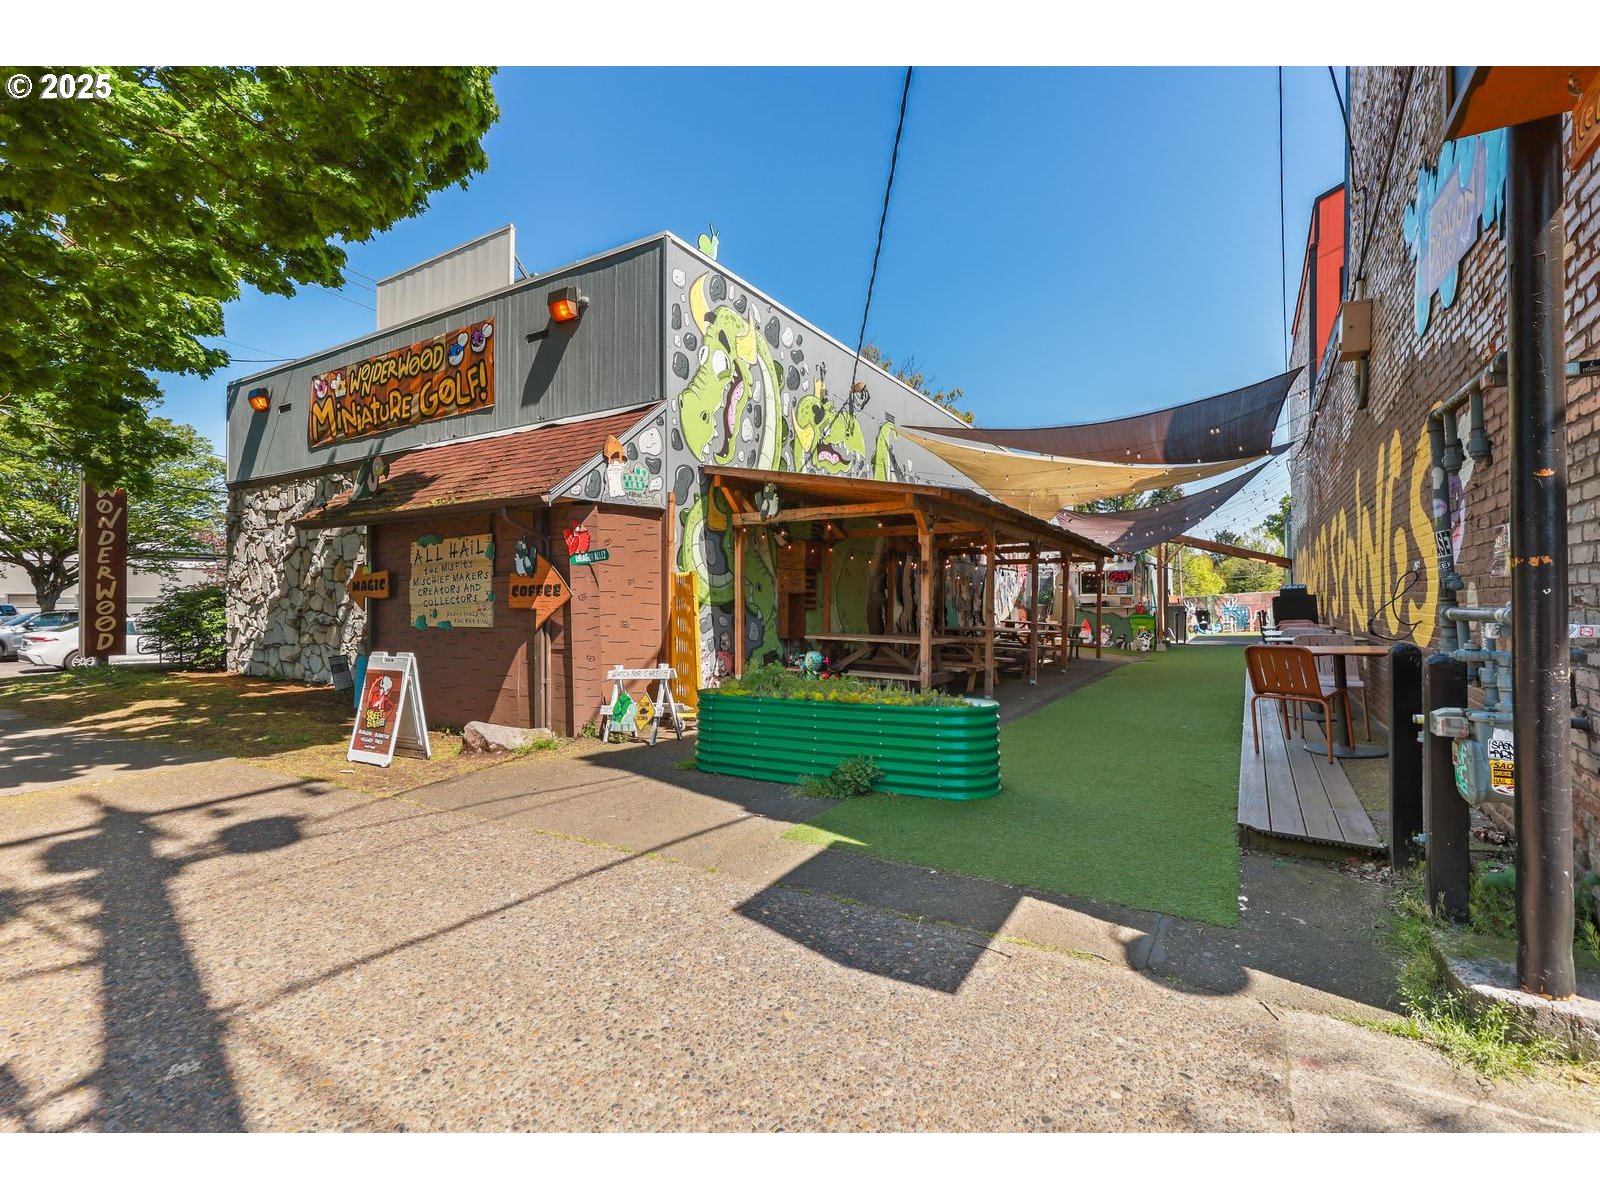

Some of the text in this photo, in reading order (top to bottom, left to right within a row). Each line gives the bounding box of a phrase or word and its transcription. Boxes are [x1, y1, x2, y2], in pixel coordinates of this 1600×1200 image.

[350, 343, 444, 397] WONDERWOOD
[419, 361, 488, 416] GOLF!
[414, 546, 443, 566] ALL
[352, 578, 385, 591] MAGIC
[452, 570, 489, 583] MAKERS
[511, 584, 560, 597] COFFEE
